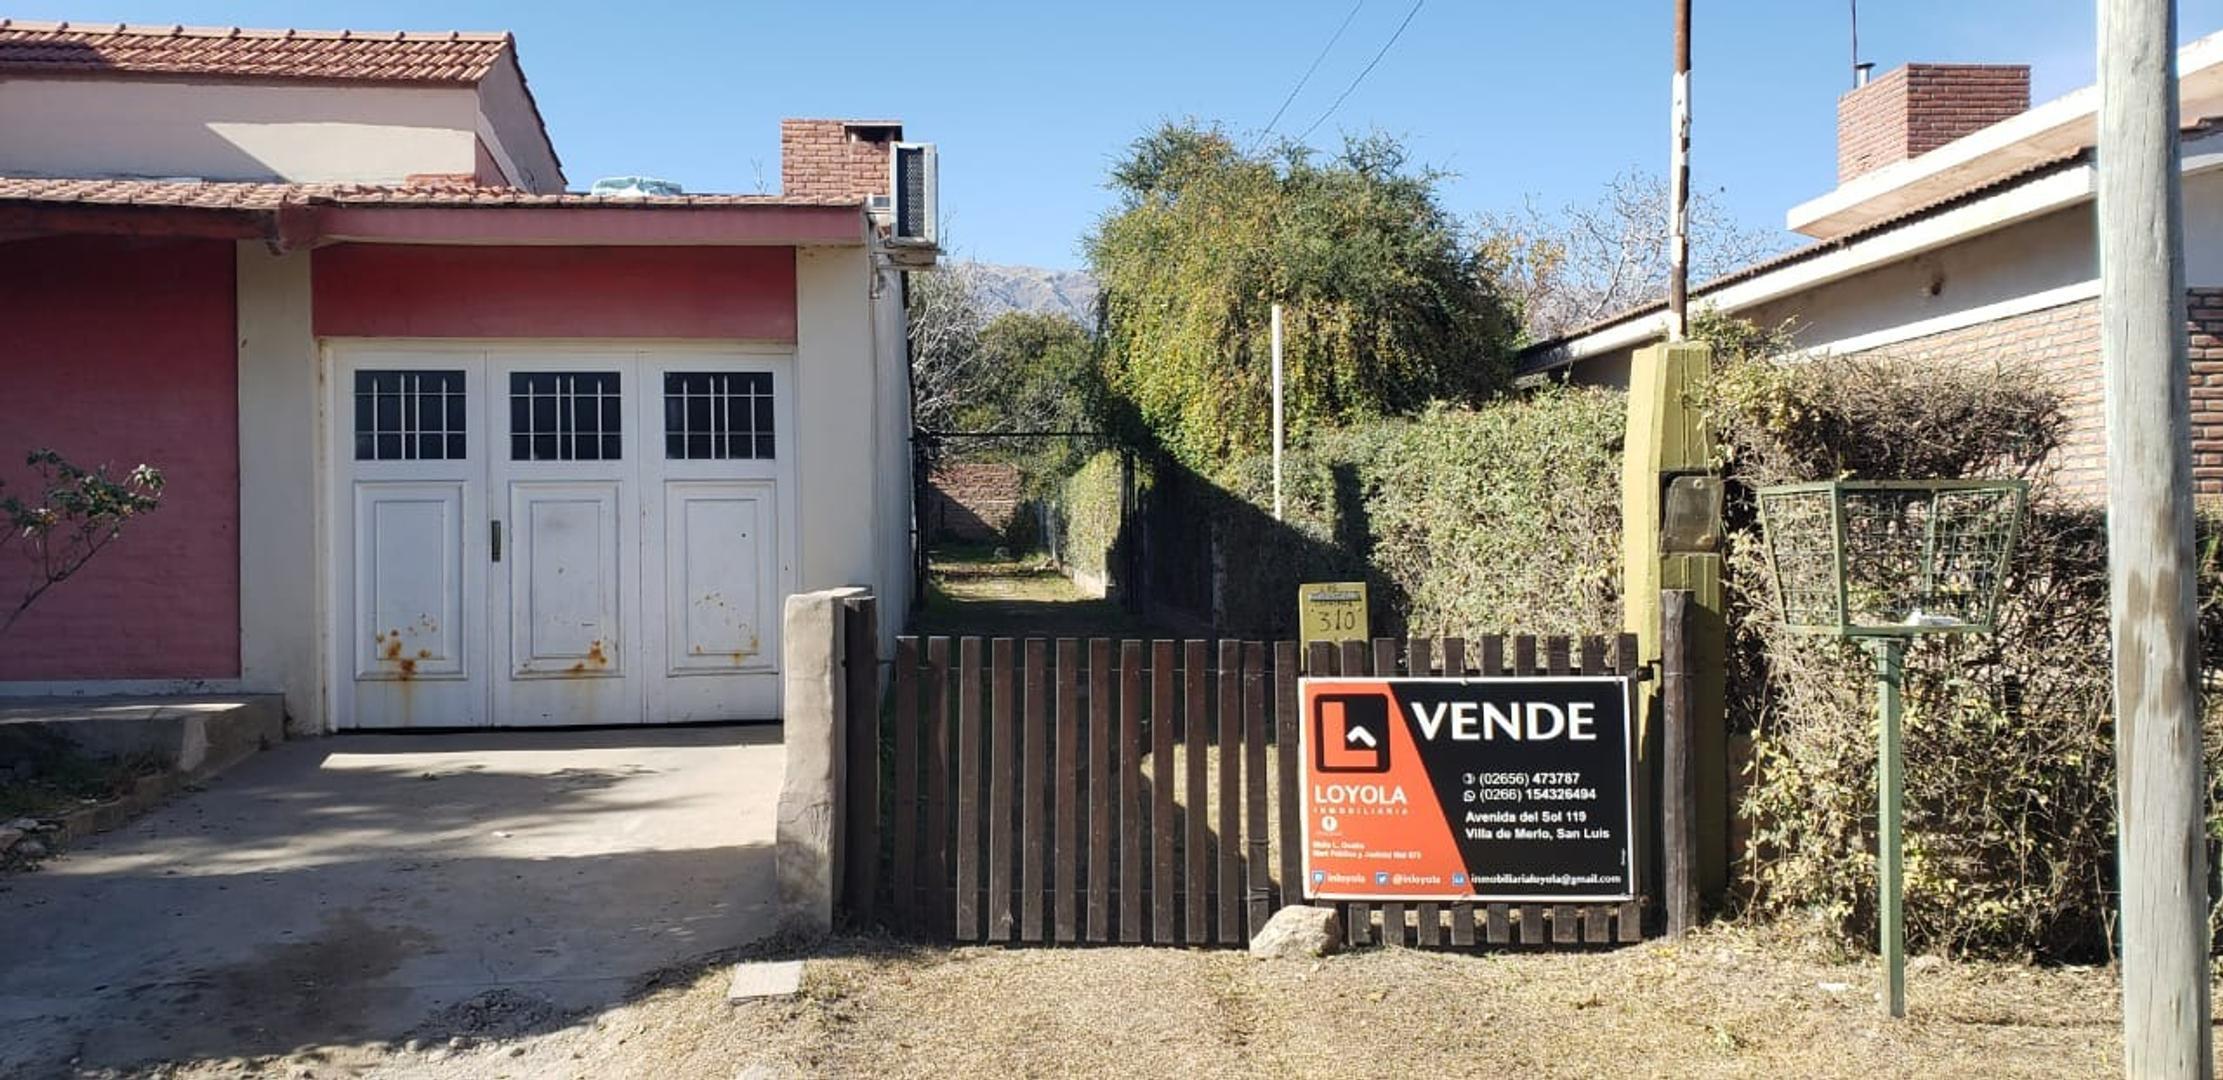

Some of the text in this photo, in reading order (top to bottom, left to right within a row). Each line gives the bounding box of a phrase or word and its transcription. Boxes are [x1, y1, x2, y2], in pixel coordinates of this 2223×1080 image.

[1318, 608, 1356, 632] 310
[1410, 701, 1597, 741] VENDE
[1479, 772, 1580, 787] (02656) 473787
[1314, 784, 1408, 805] LOYOLA
[1479, 788, 1597, 803] (0266) 154326494
[1465, 811, 1587, 823] Avenida del Sol 119
[1465, 828, 1610, 841] Villa de Merlo, San Luis
